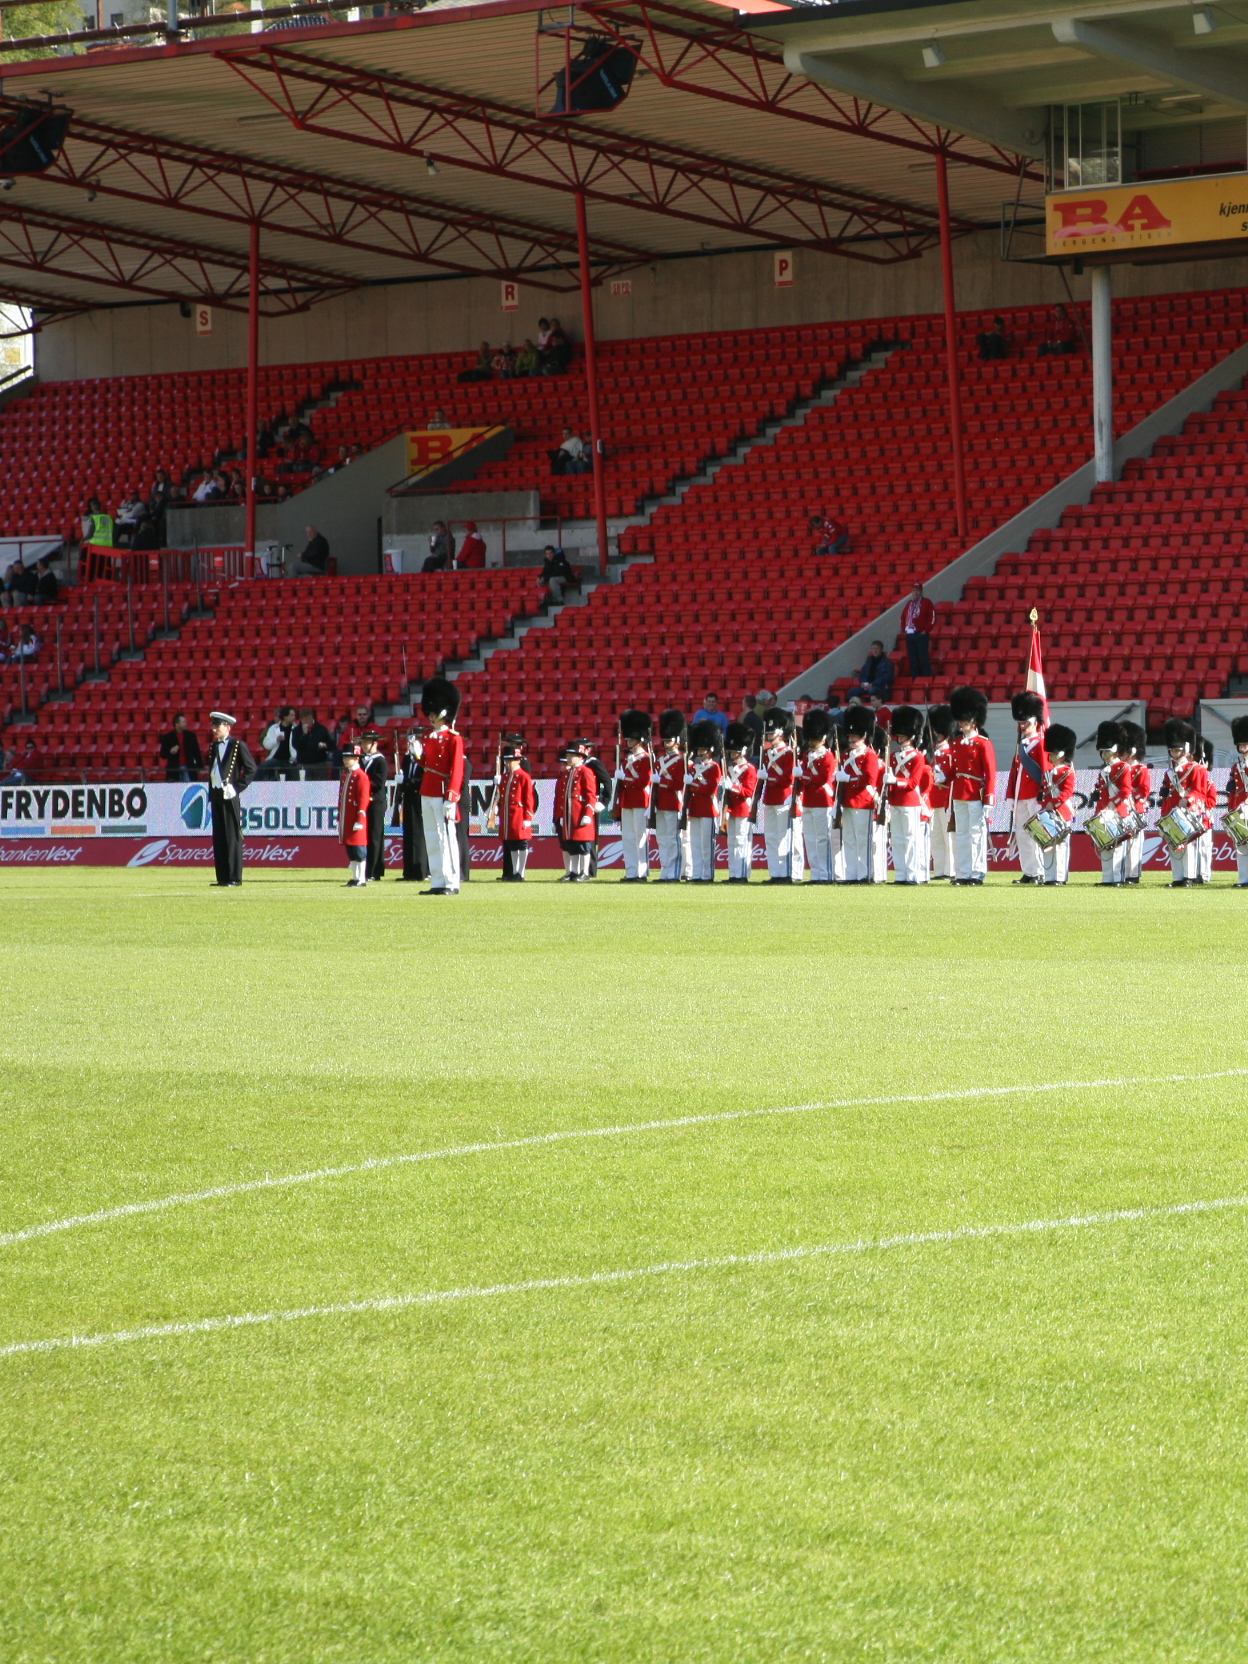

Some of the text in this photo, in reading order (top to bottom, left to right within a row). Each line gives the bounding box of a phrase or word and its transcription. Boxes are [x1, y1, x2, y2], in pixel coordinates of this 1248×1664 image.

[1053, 194, 1172, 239] BA
[779, 258, 789, 277] P
[504, 283, 516, 301] R
[199, 310, 209, 327] S
[1, 785, 148, 820] FRYDENBØ
